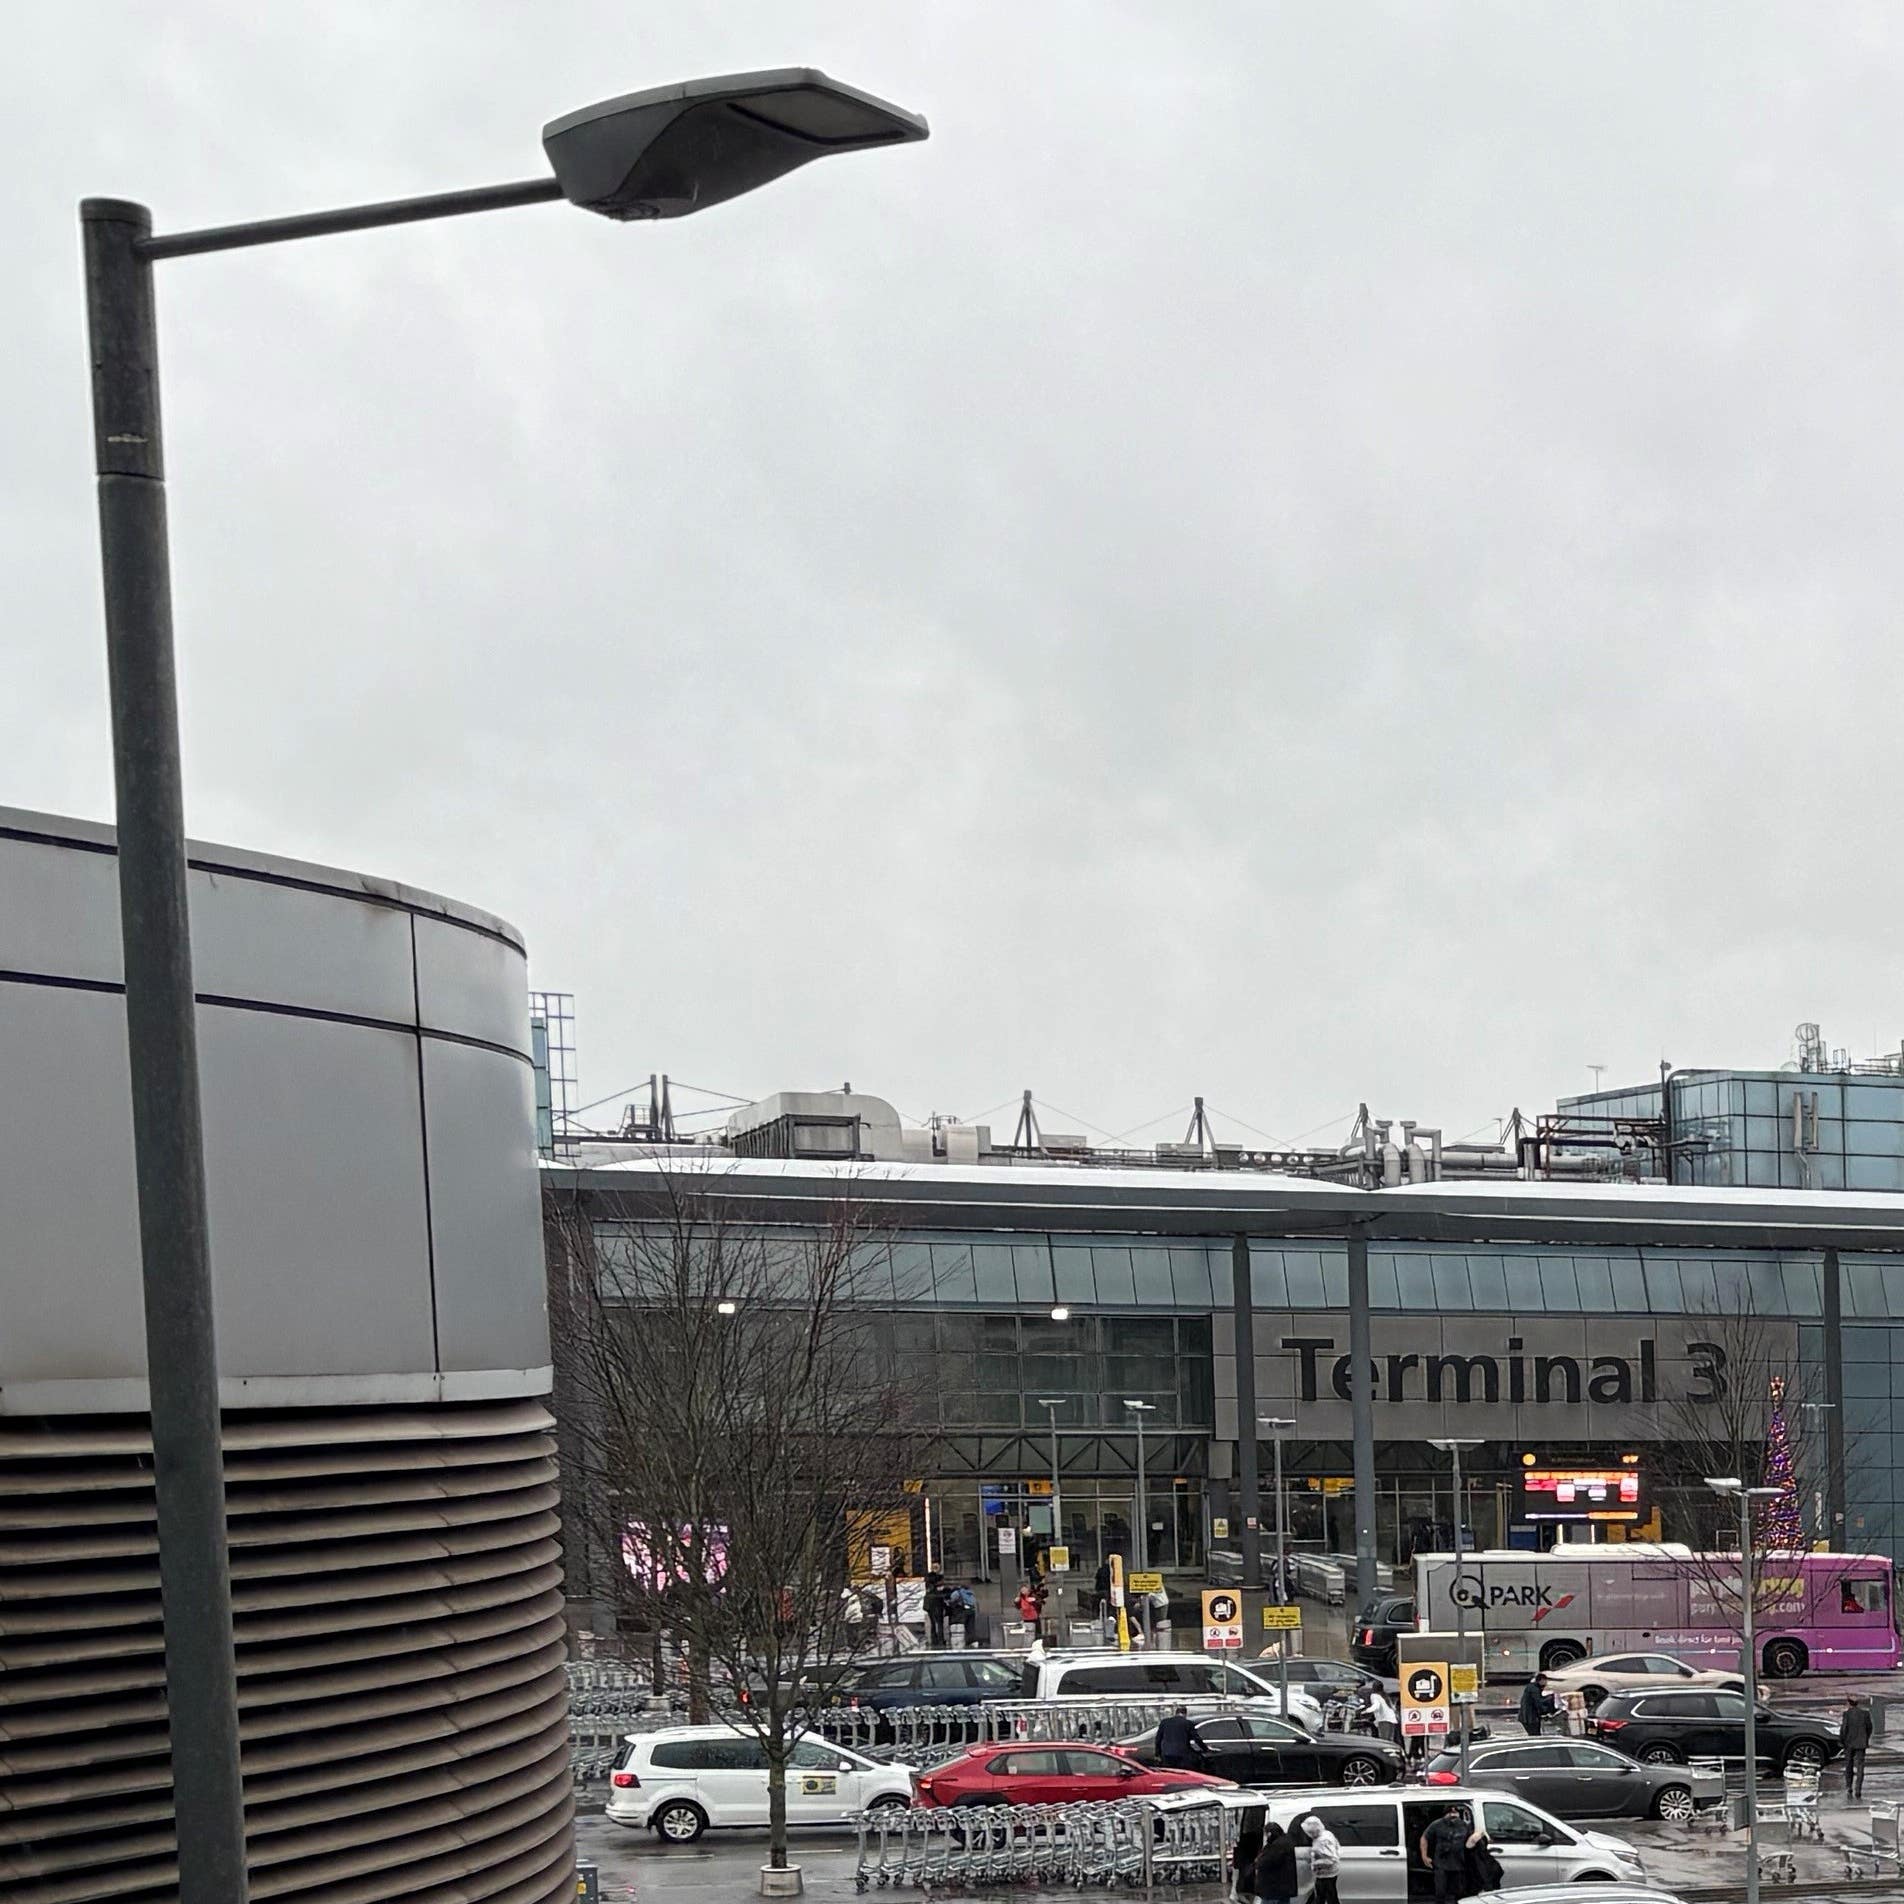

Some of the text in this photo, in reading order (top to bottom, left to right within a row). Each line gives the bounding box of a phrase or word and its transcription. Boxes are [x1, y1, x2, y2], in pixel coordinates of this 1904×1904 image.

[1281, 1337, 1728, 1404] Terminal 3
[1490, 1586, 1553, 1606] PARK
